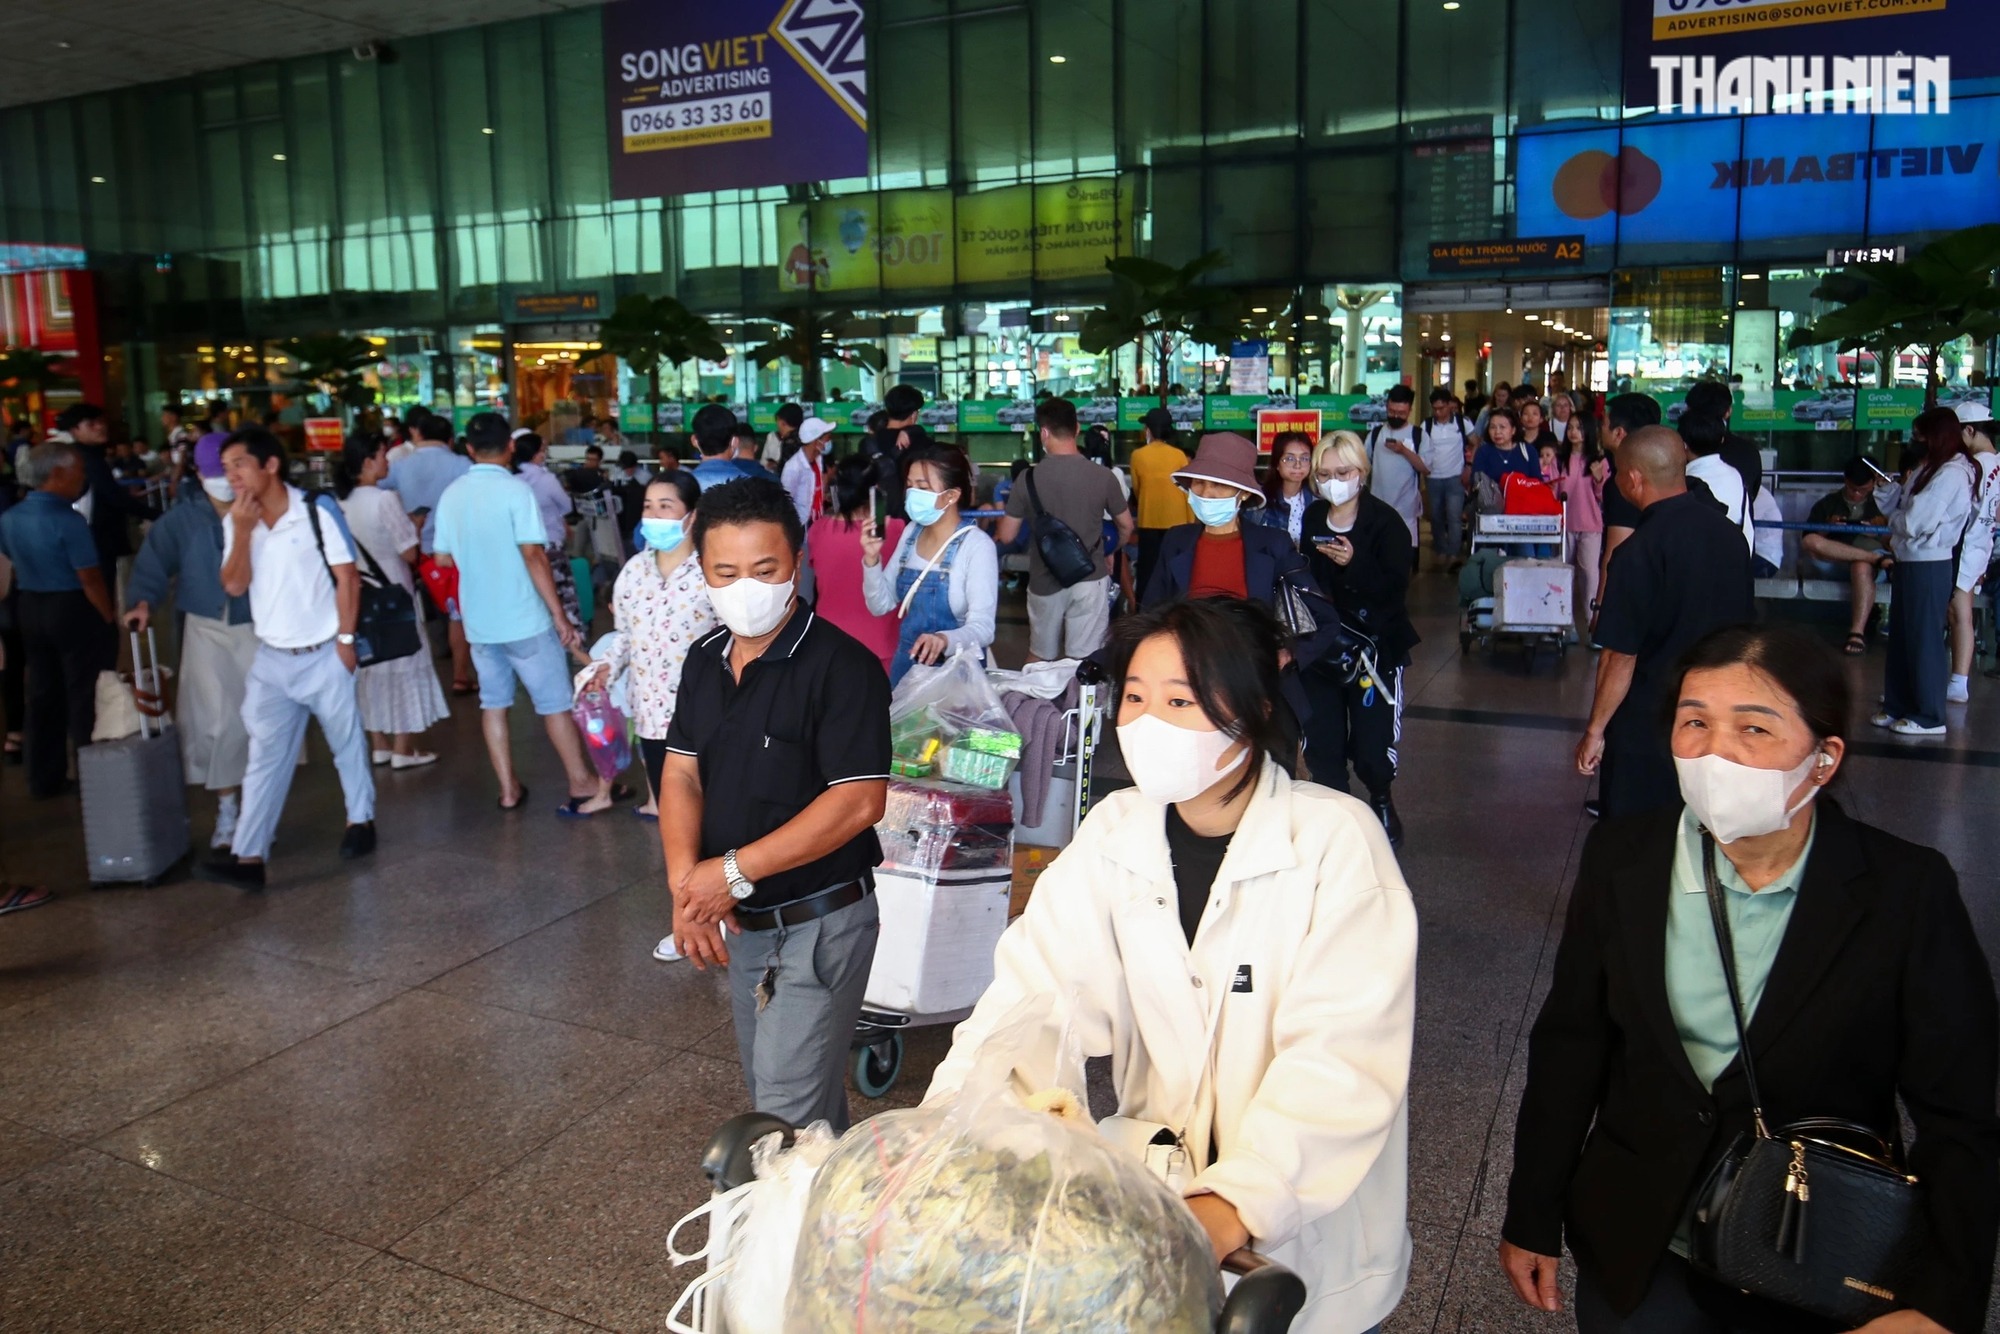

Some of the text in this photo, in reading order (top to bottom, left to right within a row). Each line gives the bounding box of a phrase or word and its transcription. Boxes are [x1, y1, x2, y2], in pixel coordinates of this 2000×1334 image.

[1667, 0, 1933, 31] ADVERTISING@SONGVIET.COM.
[620, 33, 768, 82] SONGVIET
[659, 67, 770, 98] ADVERTISING
[630, 99, 763, 132] 0966 33 33 60
[1433, 248, 1449, 258] GA
[1476, 243, 1514, 255] TRONG
[1555, 242, 1581, 260] A2
[1868, 393, 1893, 401] Grab
[1081, 736, 1090, 822] GOLDSU
